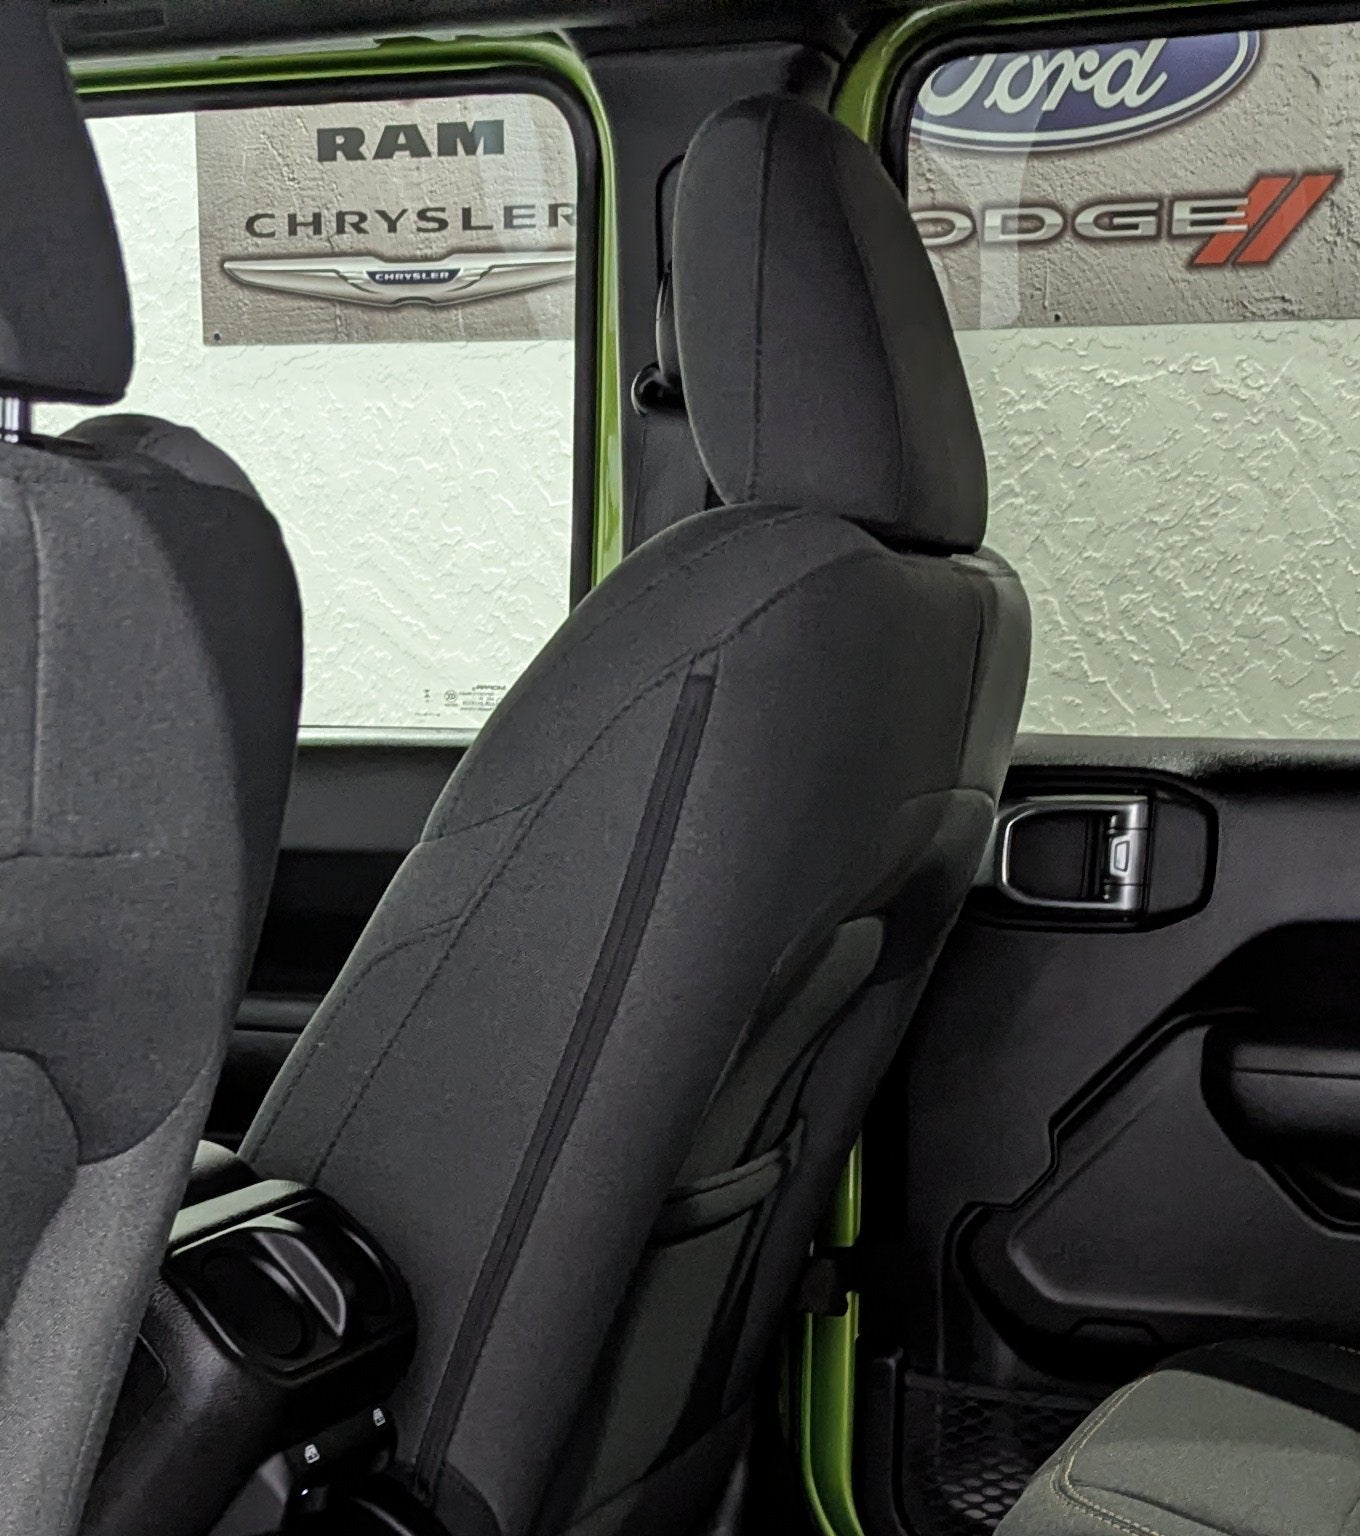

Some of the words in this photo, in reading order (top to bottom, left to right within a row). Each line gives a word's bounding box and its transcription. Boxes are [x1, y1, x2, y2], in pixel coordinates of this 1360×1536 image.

[316, 119, 505, 162] RAM
[245, 202, 577, 239] CHRYSLER
[375, 271, 450, 281] CHRYSLER
